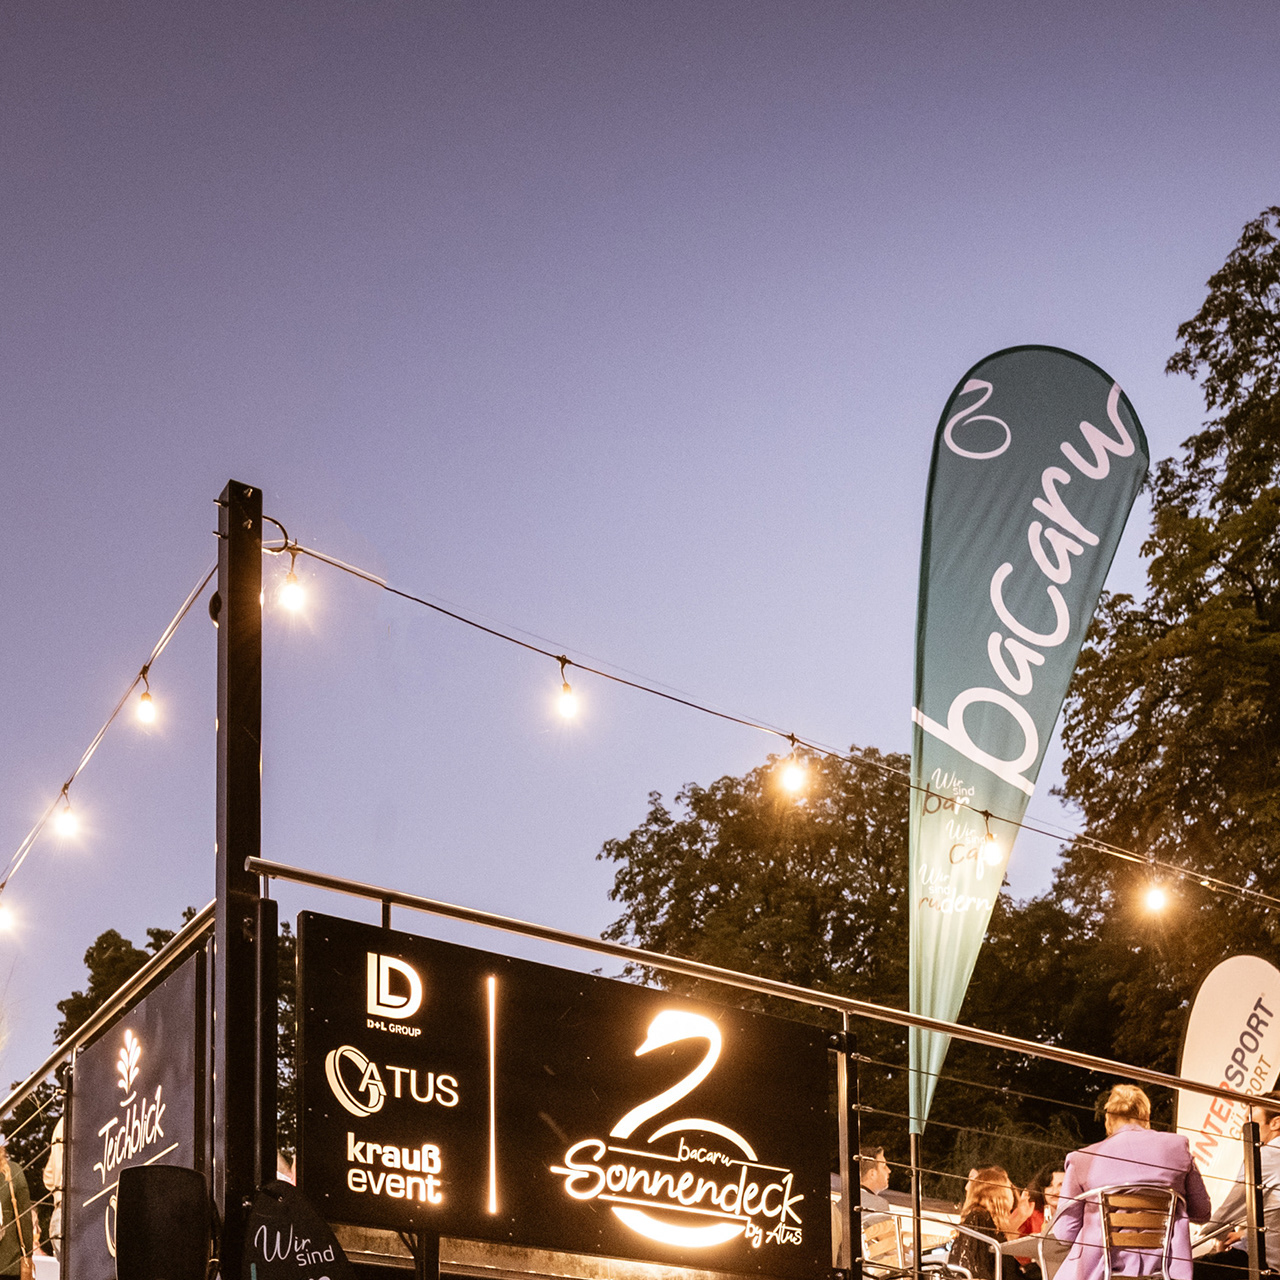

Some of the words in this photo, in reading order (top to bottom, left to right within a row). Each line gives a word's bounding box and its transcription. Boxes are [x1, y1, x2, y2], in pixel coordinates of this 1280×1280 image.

[911, 381, 1136, 796] bacaru
[922, 783, 970, 816] bar
[931, 768, 964, 790] Wir
[952, 786, 976, 796] sind
[388, 1023, 422, 1037] GROUP
[93, 1085, 166, 1184] Teichblick
[346, 1131, 442, 1174] krauß
[677, 1137, 733, 1168] bacaru
[346, 1167, 443, 1205] event
[550, 1138, 805, 1225] Sonnendeck
[254, 1224, 311, 1263] Wir
[295, 1245, 335, 1267] sind
[744, 1217, 764, 1248] by
[765, 1222, 803, 1246] Atus
